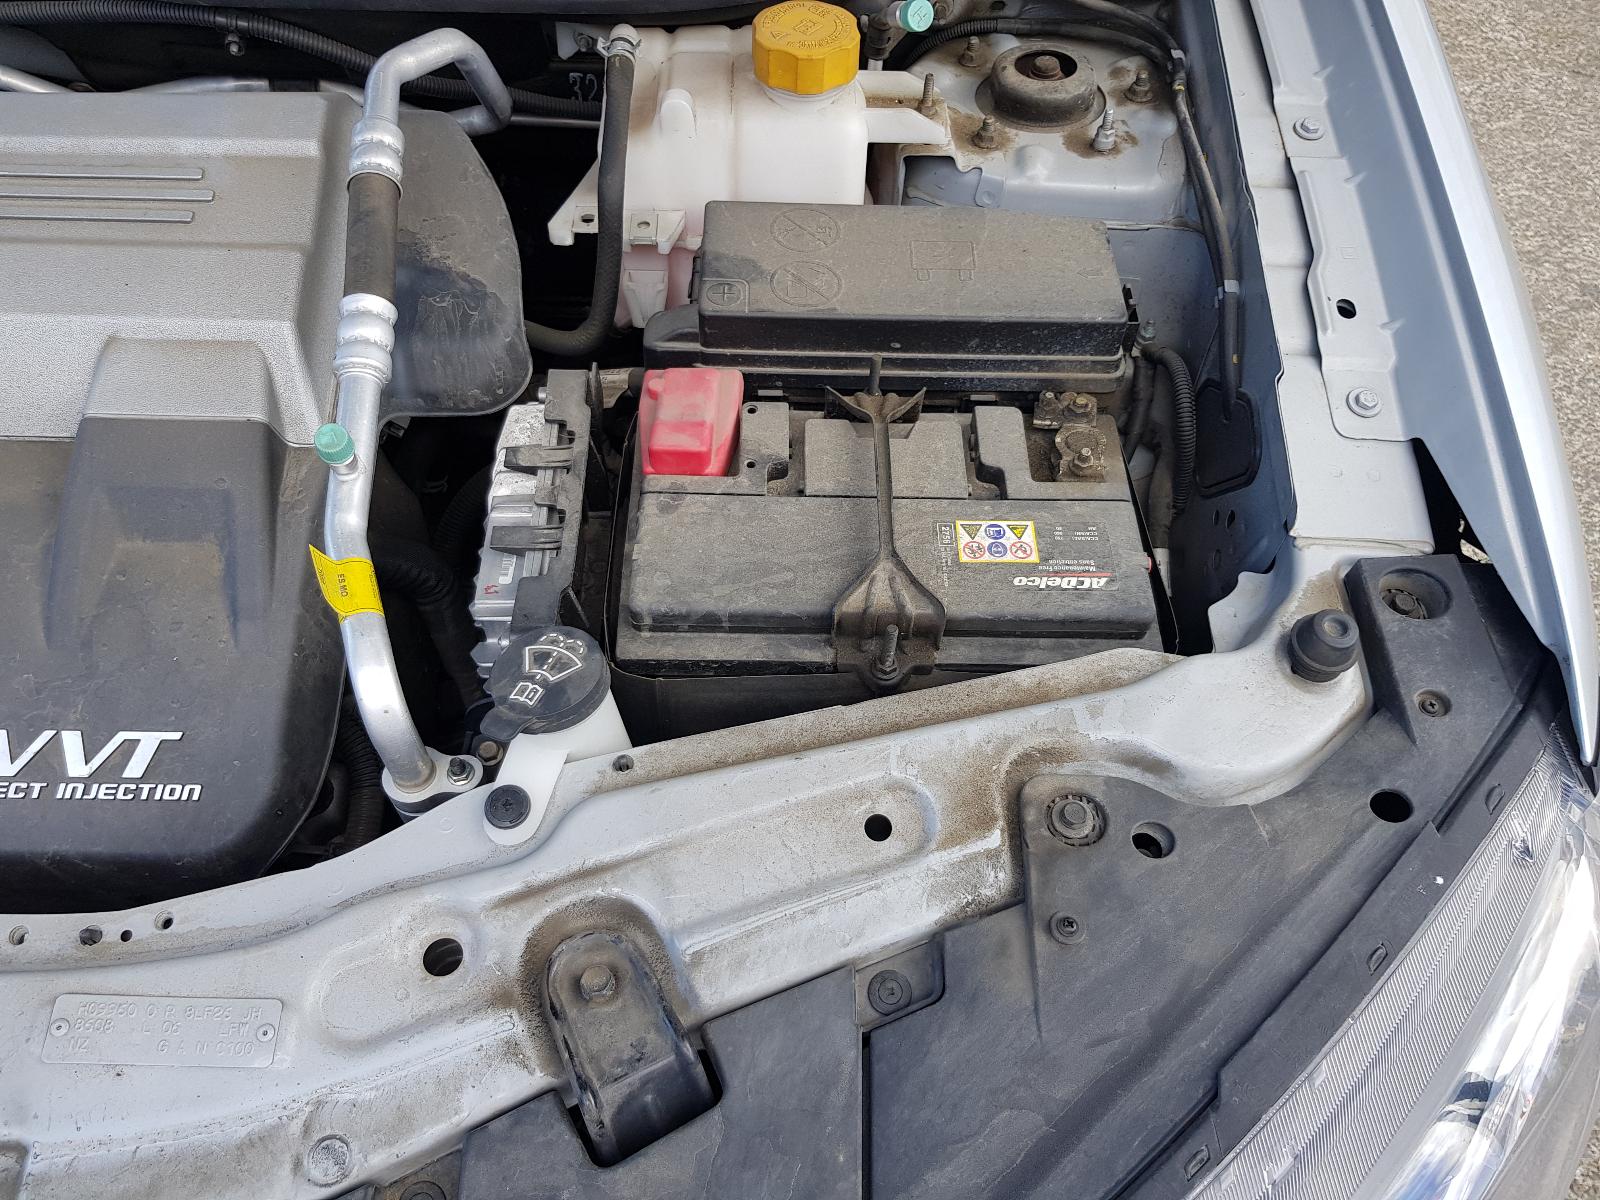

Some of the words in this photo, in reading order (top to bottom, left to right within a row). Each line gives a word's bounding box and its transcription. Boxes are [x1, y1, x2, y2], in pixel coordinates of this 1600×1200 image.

[1012, 576, 1109, 589] ACDelco
[0, 729, 184, 779] VVT
[56, 783, 203, 802] INJECTION
